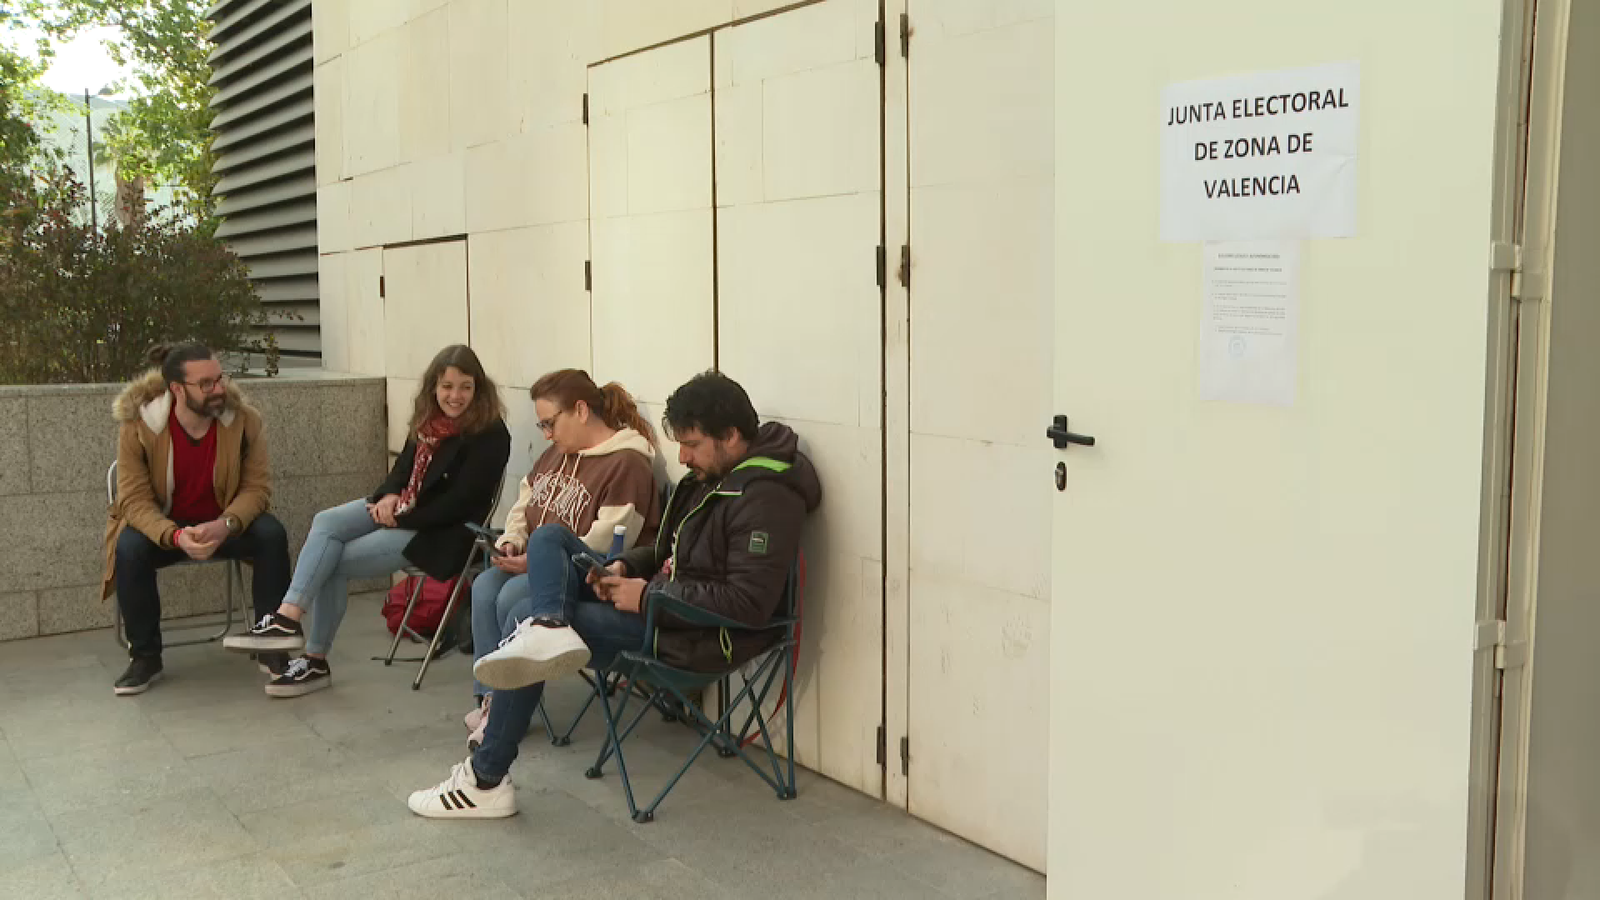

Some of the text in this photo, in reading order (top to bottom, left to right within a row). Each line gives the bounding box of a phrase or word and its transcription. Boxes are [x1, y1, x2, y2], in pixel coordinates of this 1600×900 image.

[1167, 88, 1349, 126] JUNTA ELECTORAL
[1194, 132, 1313, 161] DE ZONA DE
[1204, 174, 1301, 199] VALENCIA
